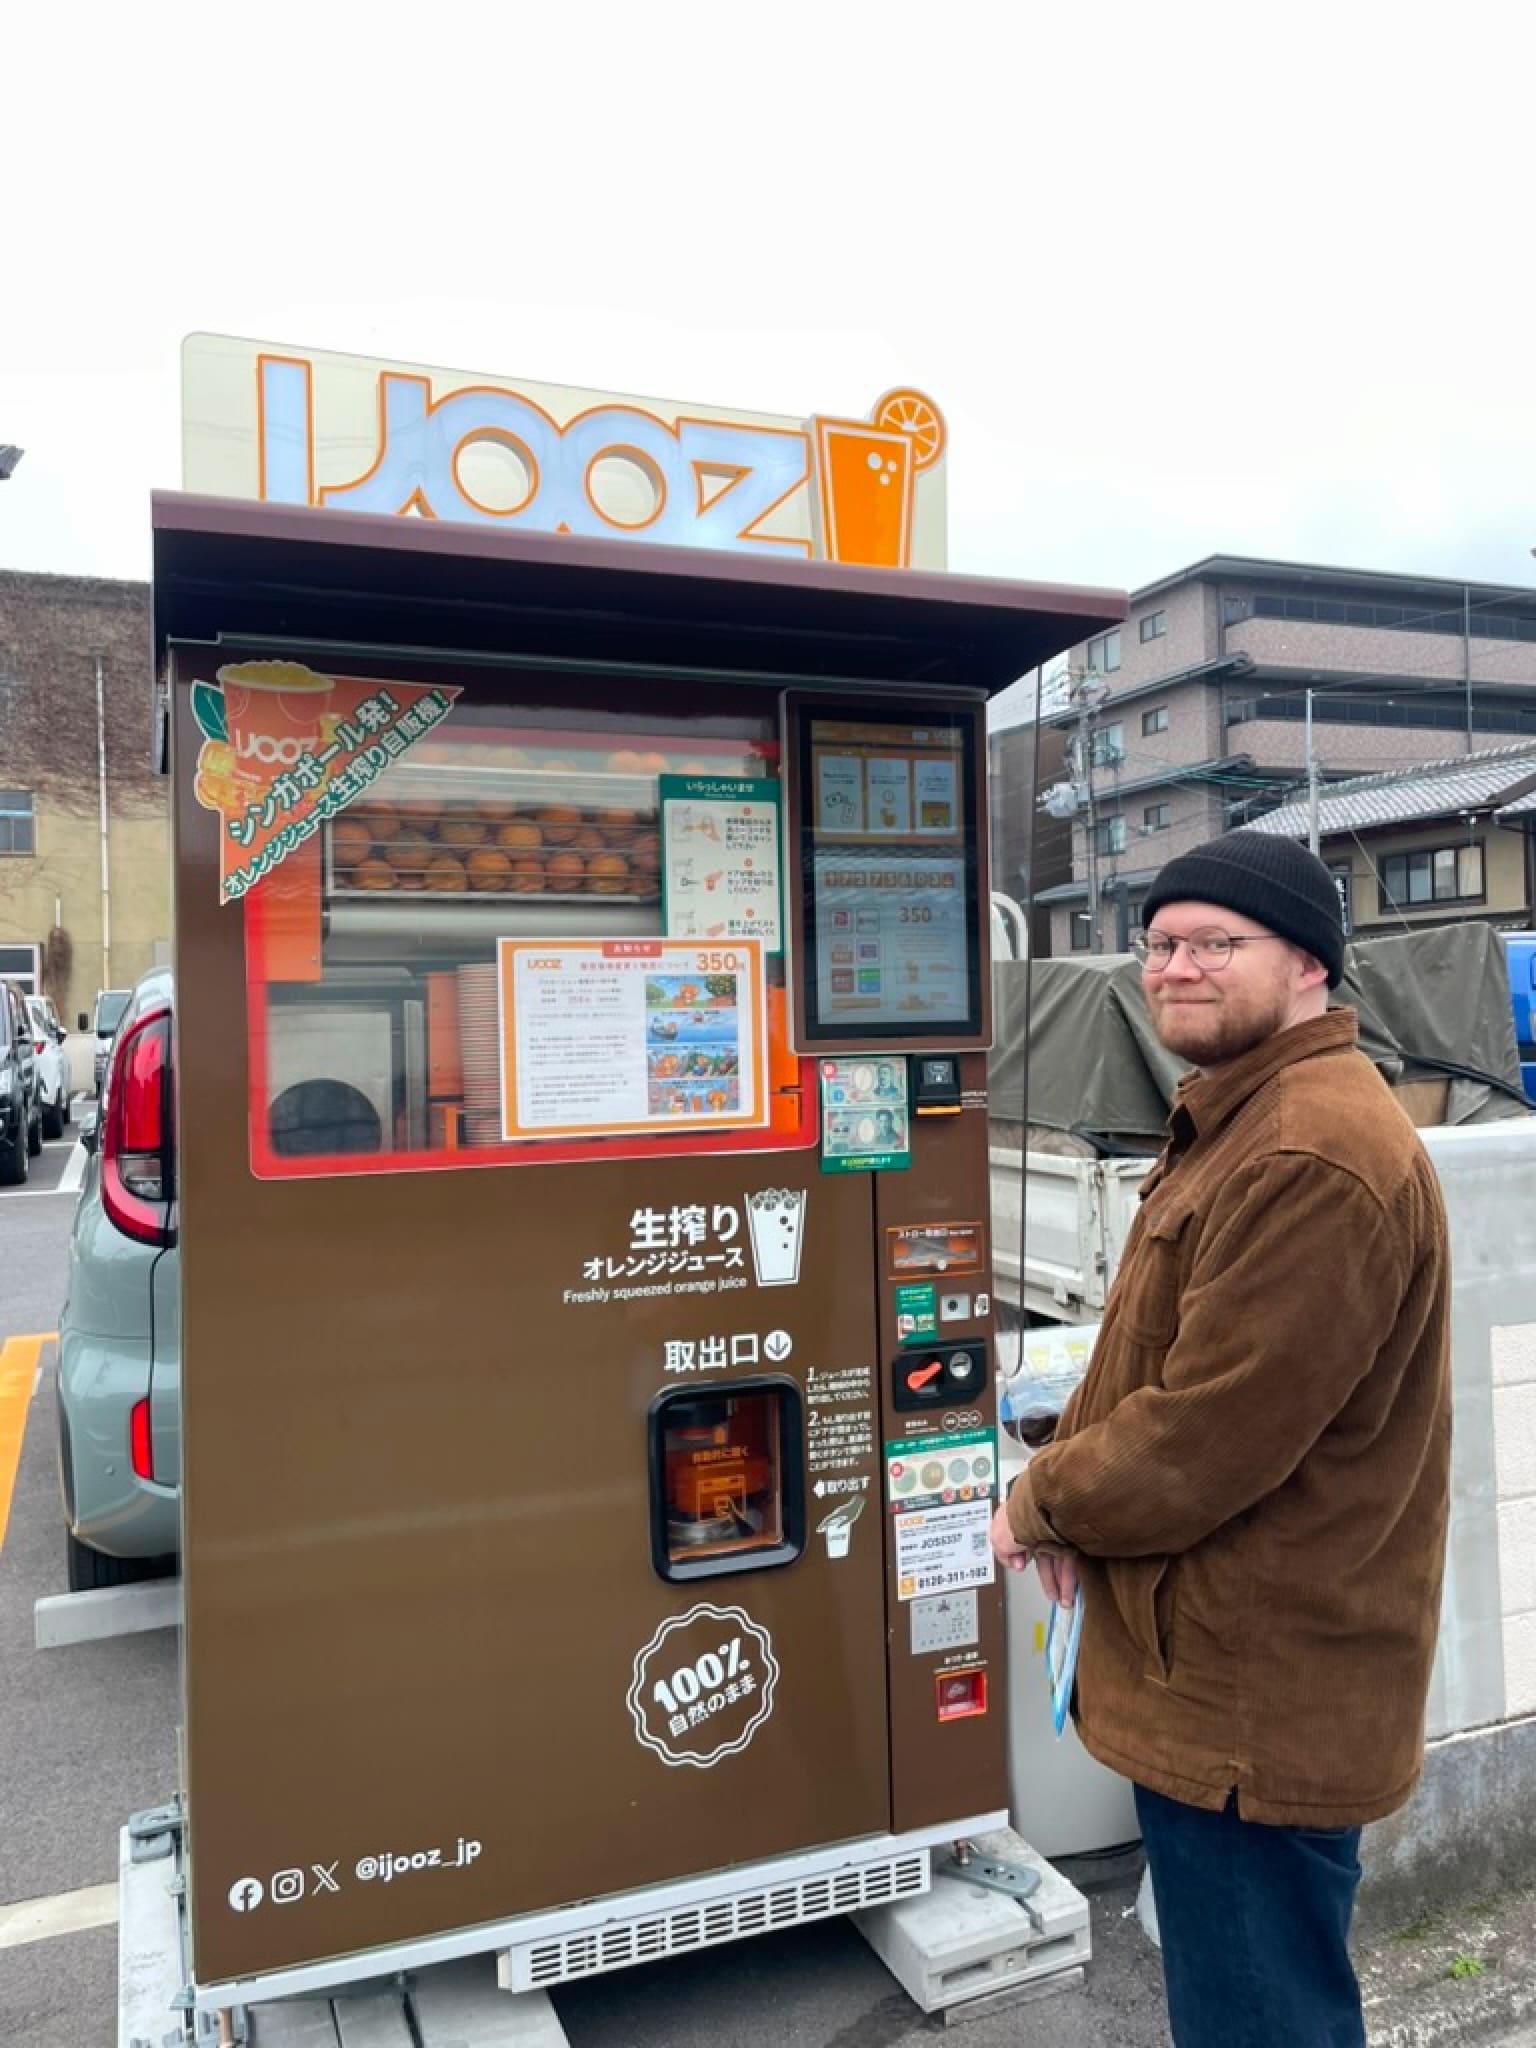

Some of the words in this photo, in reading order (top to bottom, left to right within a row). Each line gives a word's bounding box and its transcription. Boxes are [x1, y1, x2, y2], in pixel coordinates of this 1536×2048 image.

[630, 1204, 740, 1249] 生搾り
[583, 1247, 745, 1280] オレンジジュース
[563, 1286, 609, 1304] Freshly
[613, 1281, 671, 1301] squeezed
[673, 1279, 716, 1296] orange
[717, 1276, 748, 1292] juice
[664, 1333, 759, 1373] 取出口
[653, 1637, 751, 1713] 100%
[668, 1674, 757, 1738] 自然のまま
[355, 1837, 483, 1882] @ijooz_jp
